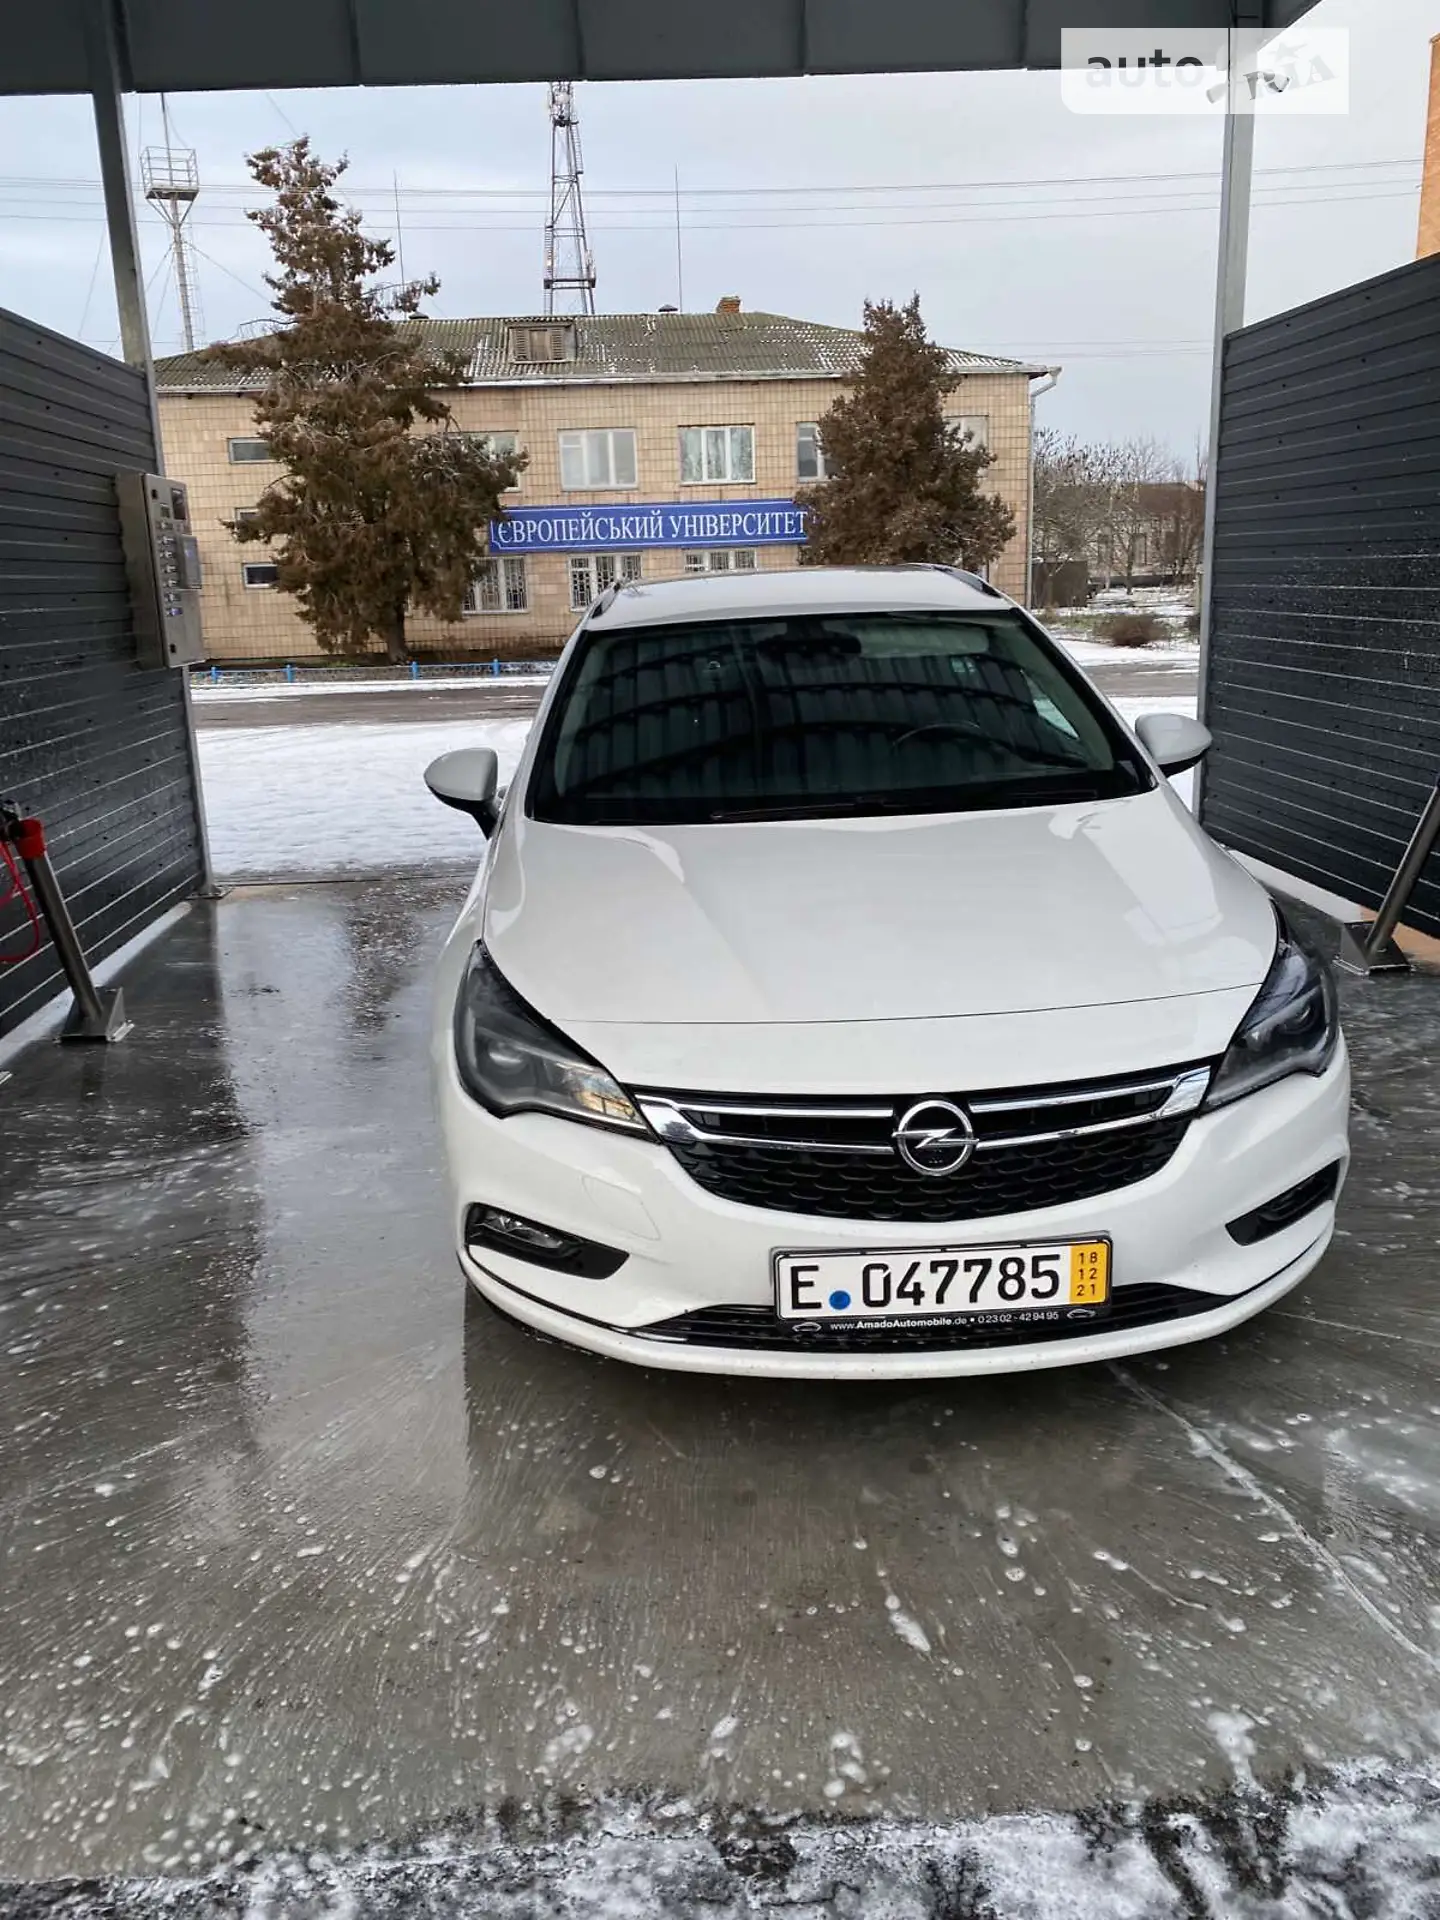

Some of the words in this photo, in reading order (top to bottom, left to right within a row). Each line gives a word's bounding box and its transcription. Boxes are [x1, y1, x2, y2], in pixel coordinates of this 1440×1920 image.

[498, 510, 664, 544] ЄВРОПЕЙСЬКИЙ
[669, 511, 808, 539] УНІВЕРСИТЕТ
[1078, 1251, 1098, 1264] 18
[1078, 1267, 1098, 1280] 12
[790, 1264, 822, 1310] E
[862, 1253, 1061, 1308] 047785
[1076, 1283, 1096, 1297] 21
[829, 1316, 968, 1331] www.AmadoAutomobile.de
